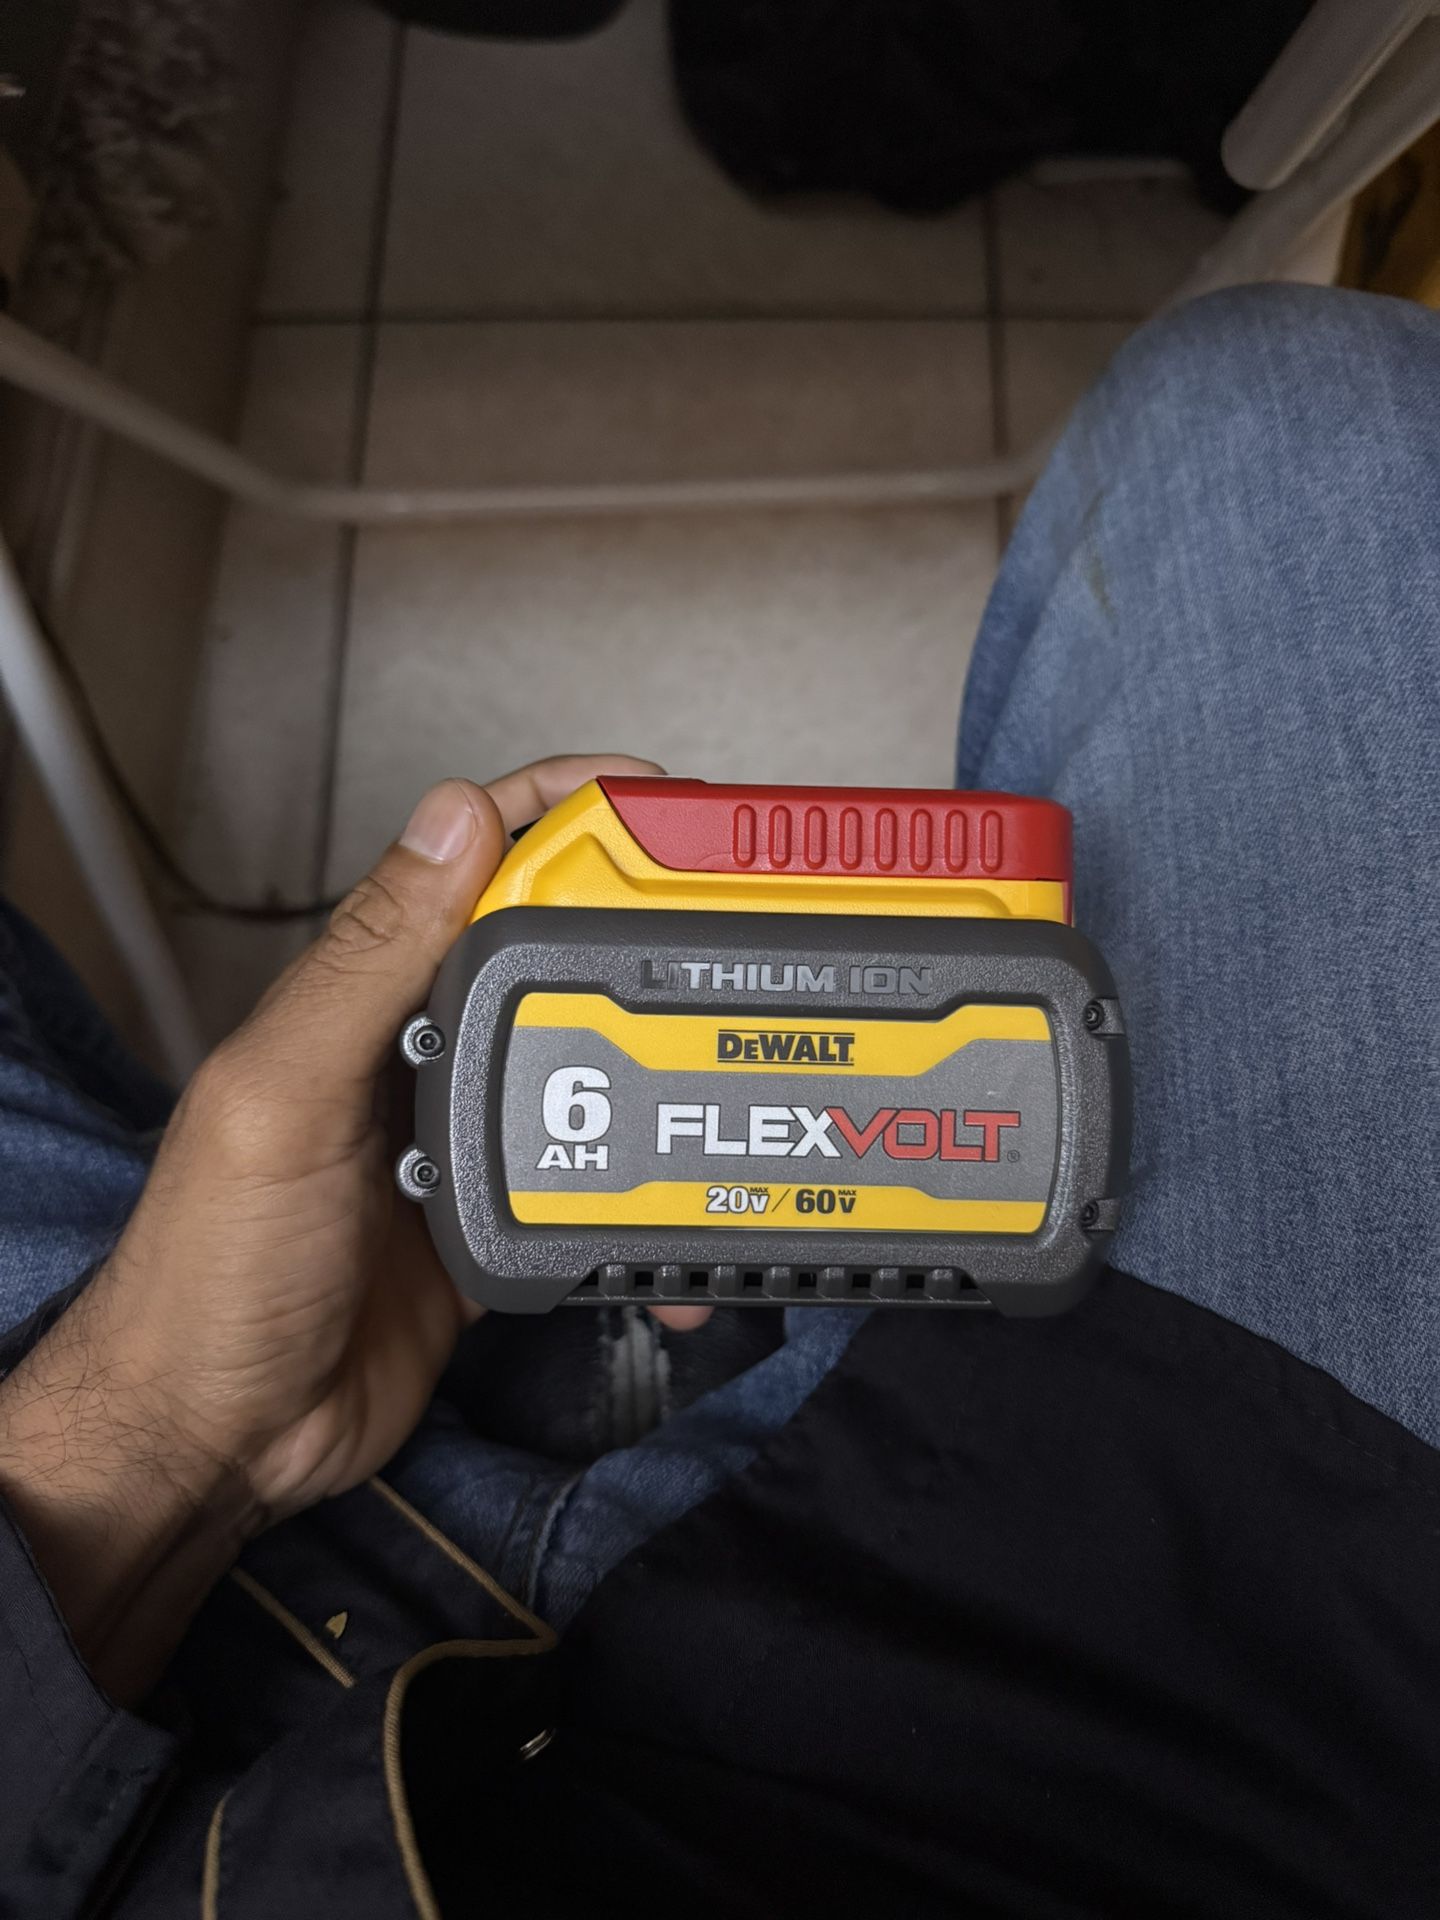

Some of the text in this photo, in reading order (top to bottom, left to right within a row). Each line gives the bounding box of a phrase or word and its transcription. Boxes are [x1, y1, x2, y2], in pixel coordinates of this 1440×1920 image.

[641, 959, 931, 995] LITHIUM ION
[541, 1065, 613, 1143] 6
[535, 1144, 609, 1171] AH
